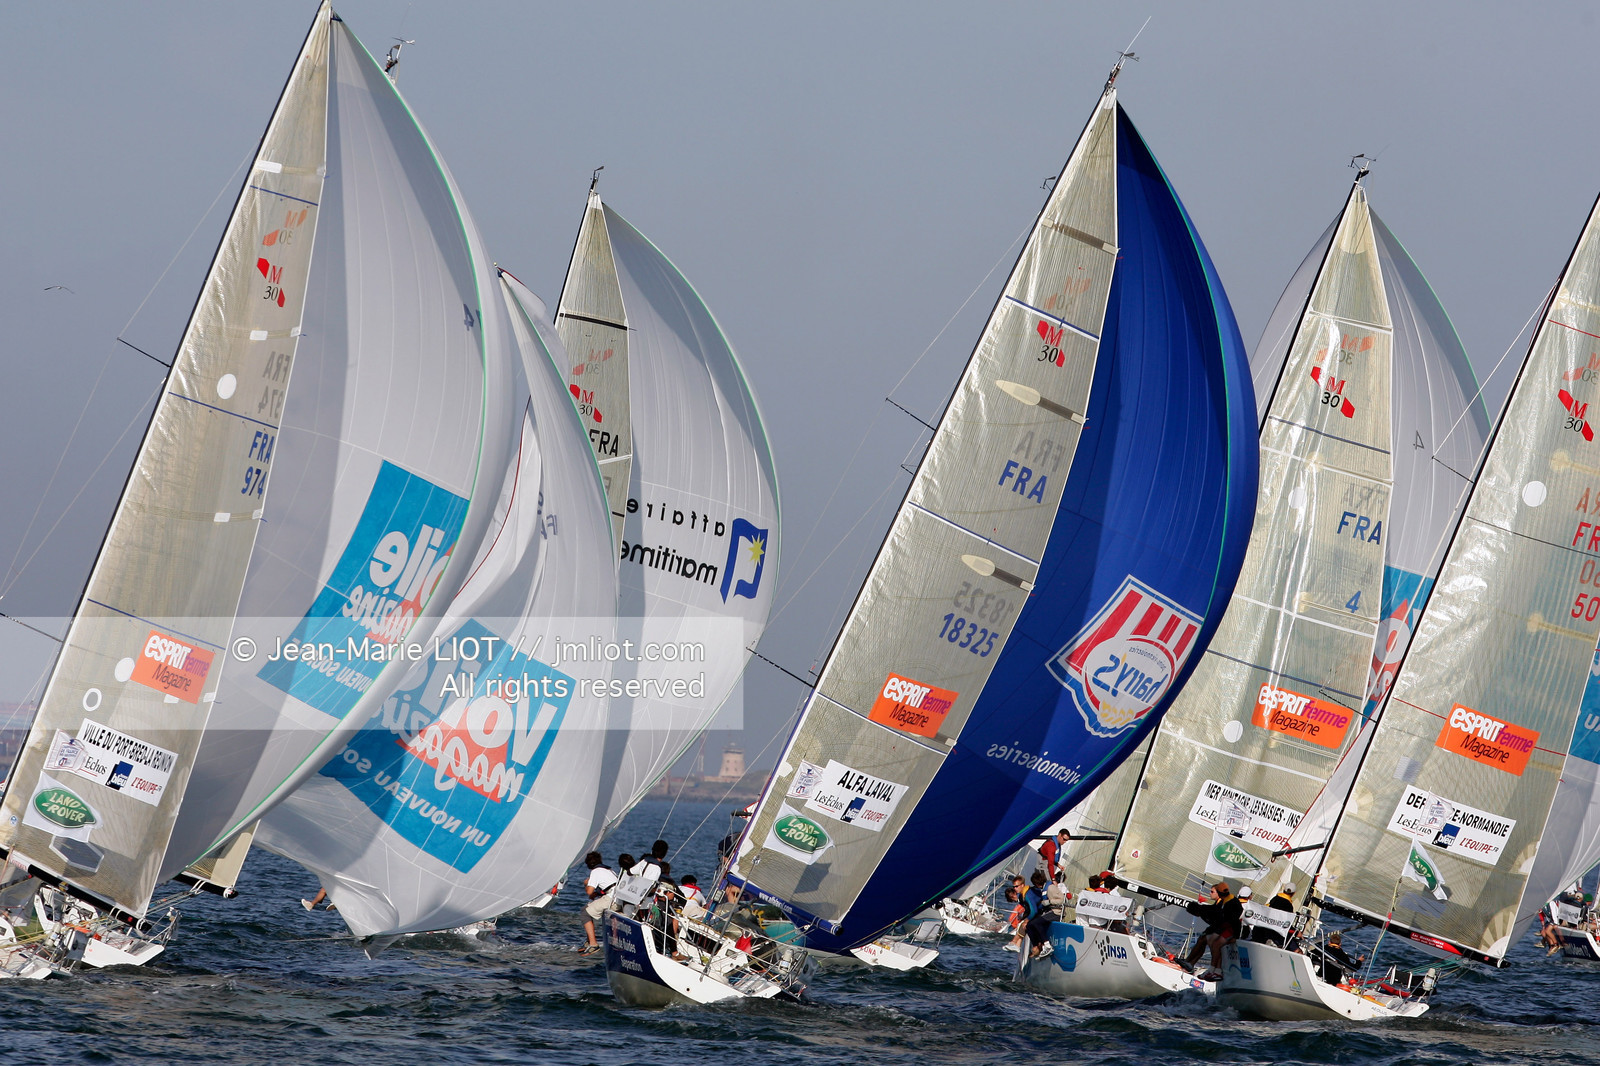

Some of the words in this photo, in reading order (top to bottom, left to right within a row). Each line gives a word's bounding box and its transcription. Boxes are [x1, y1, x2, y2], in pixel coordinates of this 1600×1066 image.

[269, 266, 283, 285] M
[263, 285, 279, 300] 30
[1044, 325, 1063, 348] M
[1037, 345, 1058, 364] 30
[1326, 377, 1345, 395] M
[581, 390, 594, 404] M
[1322, 392, 1340, 408] 30
[580, 404, 593, 416] 30
[1571, 402, 1588, 418] M
[1564, 417, 1583, 432] 30
[248, 431, 274, 464] FRA
[588, 429, 619, 457] FRA
[242, 466, 267, 499] 974
[998, 460, 1047, 504] FRA
[1336, 512, 1383, 545] FRA
[1344, 591, 1361, 613] 4
[938, 612, 998, 658] 18325
[152, 664, 192, 693] Magazine
[889, 703, 928, 728] Magazine
[1270, 710, 1320, 737] Magazine
[83, 723, 106, 747] VILLE
[101, 732, 117, 751] DU
[1460, 734, 1510, 764] Magazine
[85, 756, 108, 775] Echos
[837, 770, 870, 794] ALFA
[865, 779, 897, 803] LAVAL
[1204, 782, 1223, 799] MER
[50, 792, 81, 809] LAND
[47, 804, 86, 822] ROVER
[1107, 944, 1128, 960] INSA
